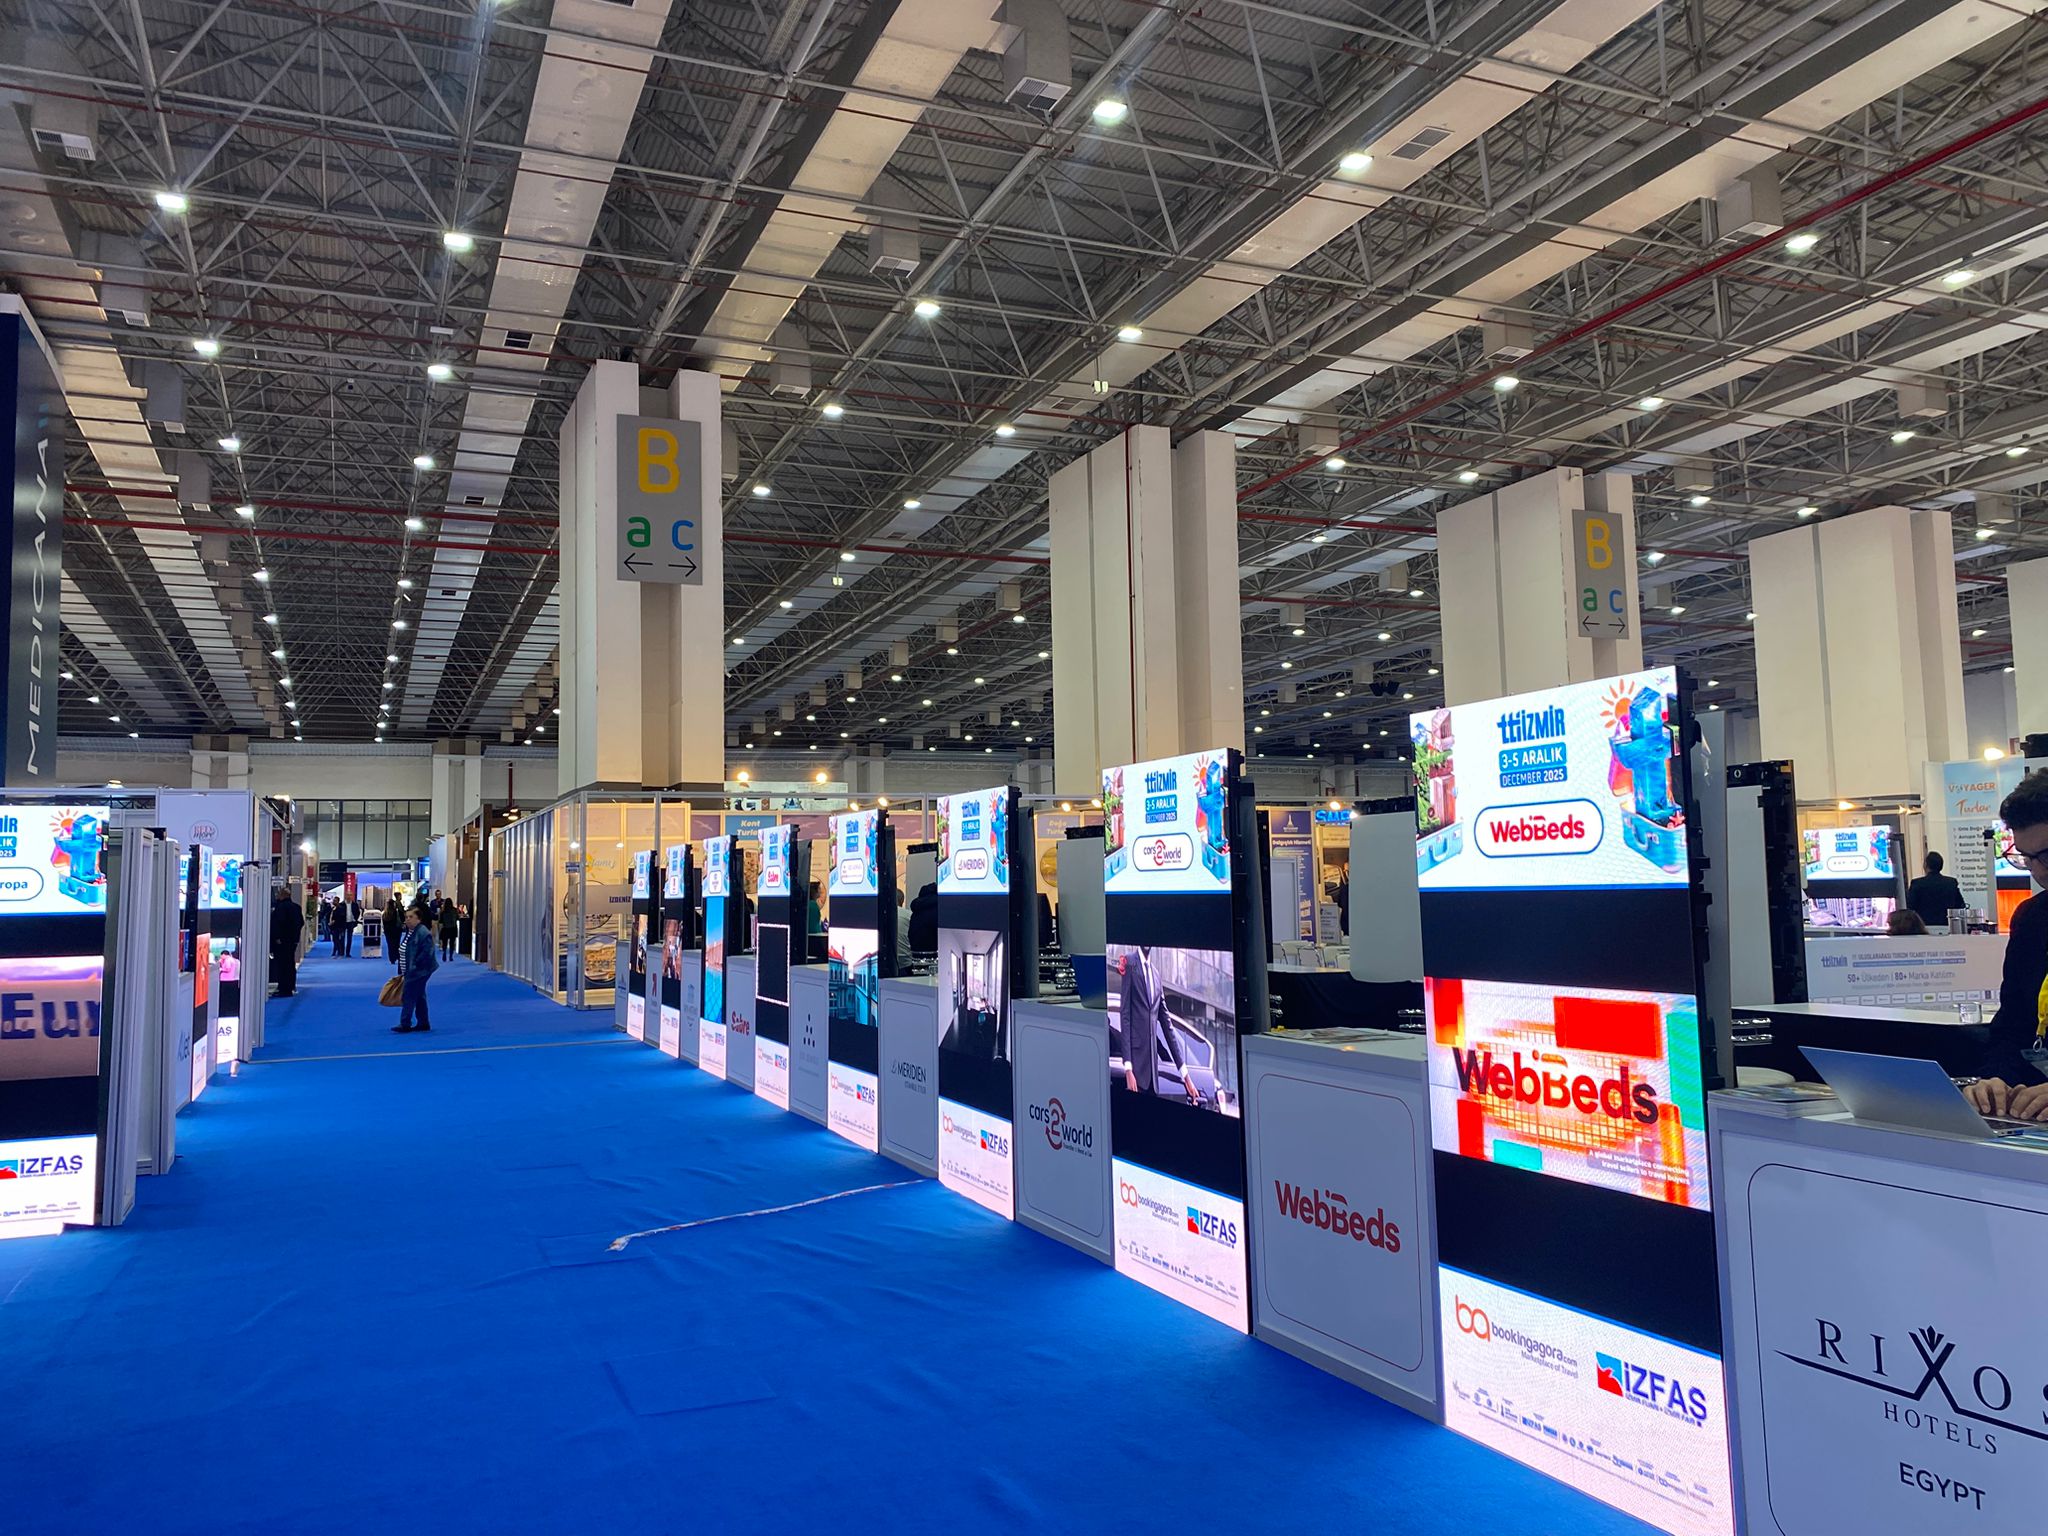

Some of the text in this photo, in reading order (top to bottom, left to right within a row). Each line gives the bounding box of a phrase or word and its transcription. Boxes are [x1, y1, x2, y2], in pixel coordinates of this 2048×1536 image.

[637, 427, 680, 494] B
[626, 516, 694, 551] a c
[1585, 518, 1613, 570] B
[27, 437, 49, 776] MEDICANA
[1582, 587, 1623, 614] a c
[1501, 746, 1564, 769] 3-5 ARALIK
[1502, 768, 1565, 787] DECEMBER 2025
[1156, 796, 1177, 809] ARALIK
[1489, 814, 1585, 843] WebBeds
[1452, 1046, 1659, 1125] WebBeds
[1274, 1179, 1401, 1254] WebBeds
[1884, 1402, 1998, 1455] HOTELS
[1900, 1462, 1987, 1511] EGYPT
